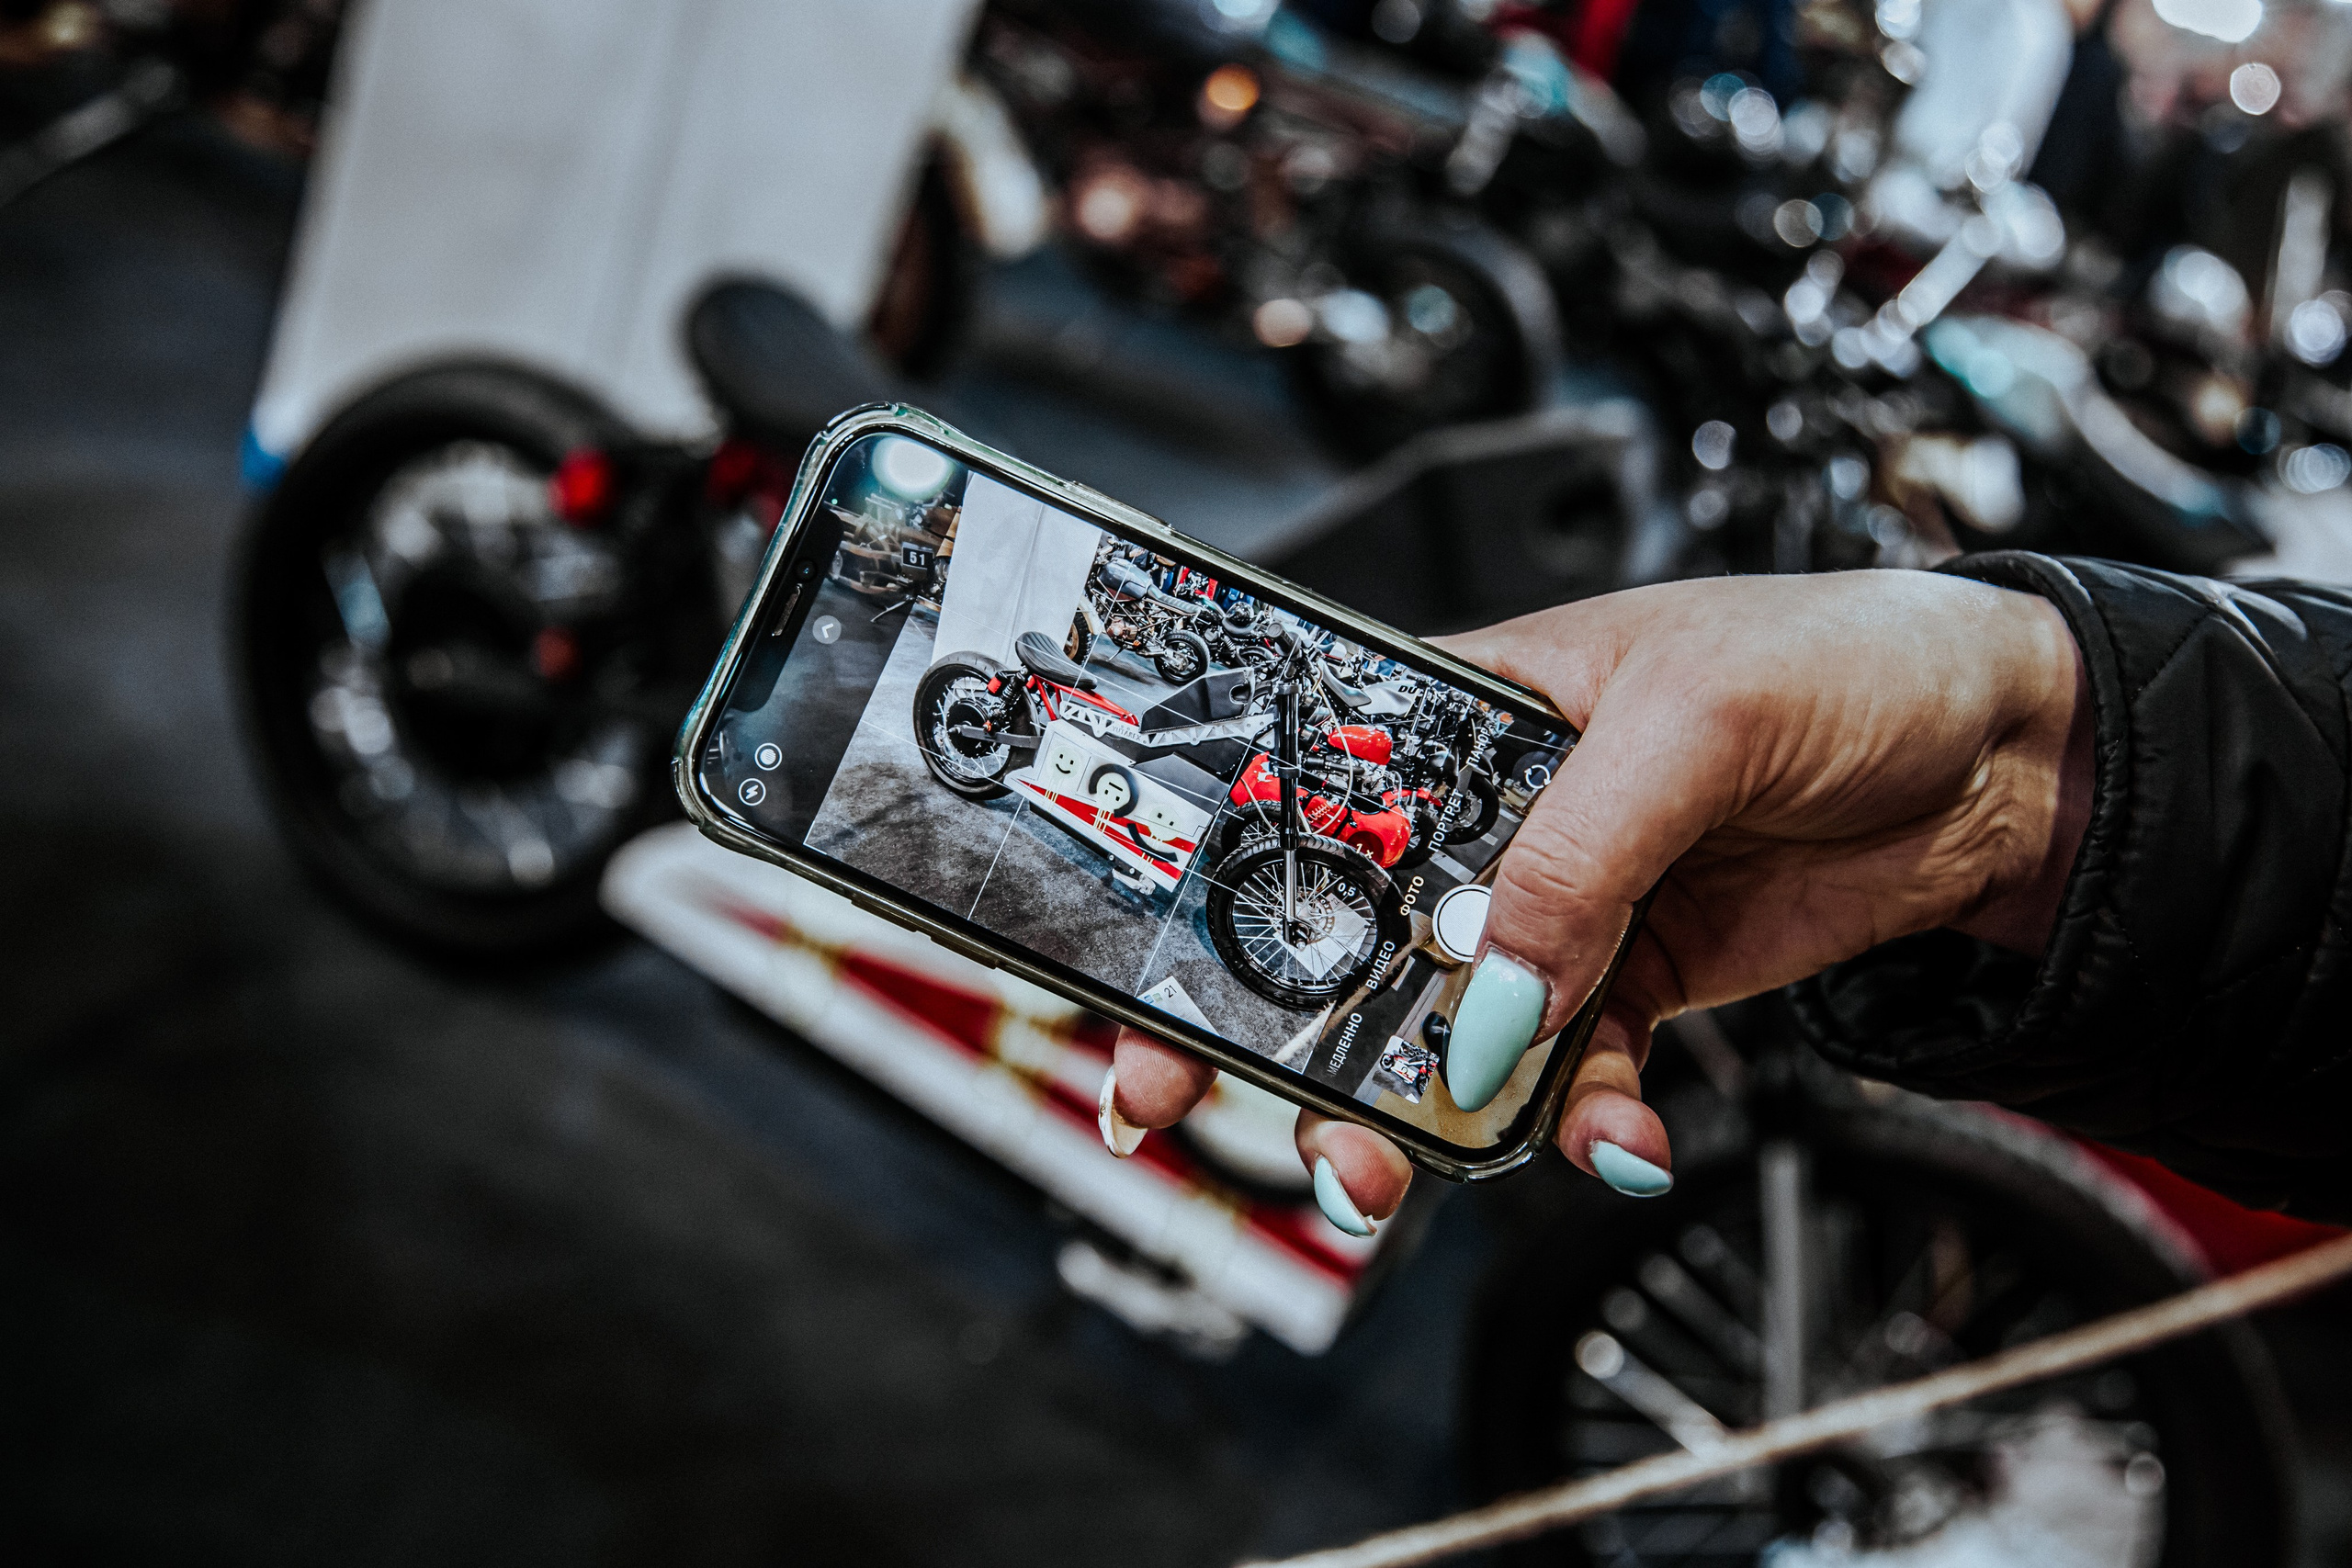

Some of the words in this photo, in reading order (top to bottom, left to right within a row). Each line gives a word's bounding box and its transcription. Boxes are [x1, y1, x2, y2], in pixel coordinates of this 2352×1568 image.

[910, 551, 925, 566] 51
[1428, 787, 1464, 852] ПОРТРЕТ
[1338, 883, 1357, 897] 0,5
[1399, 875, 1425, 916] ФОТО
[1365, 940, 1396, 990] ВИДЕО
[1164, 985, 1177, 998] 21
[1326, 1012, 1363, 1077] МЕДЛЕННО
